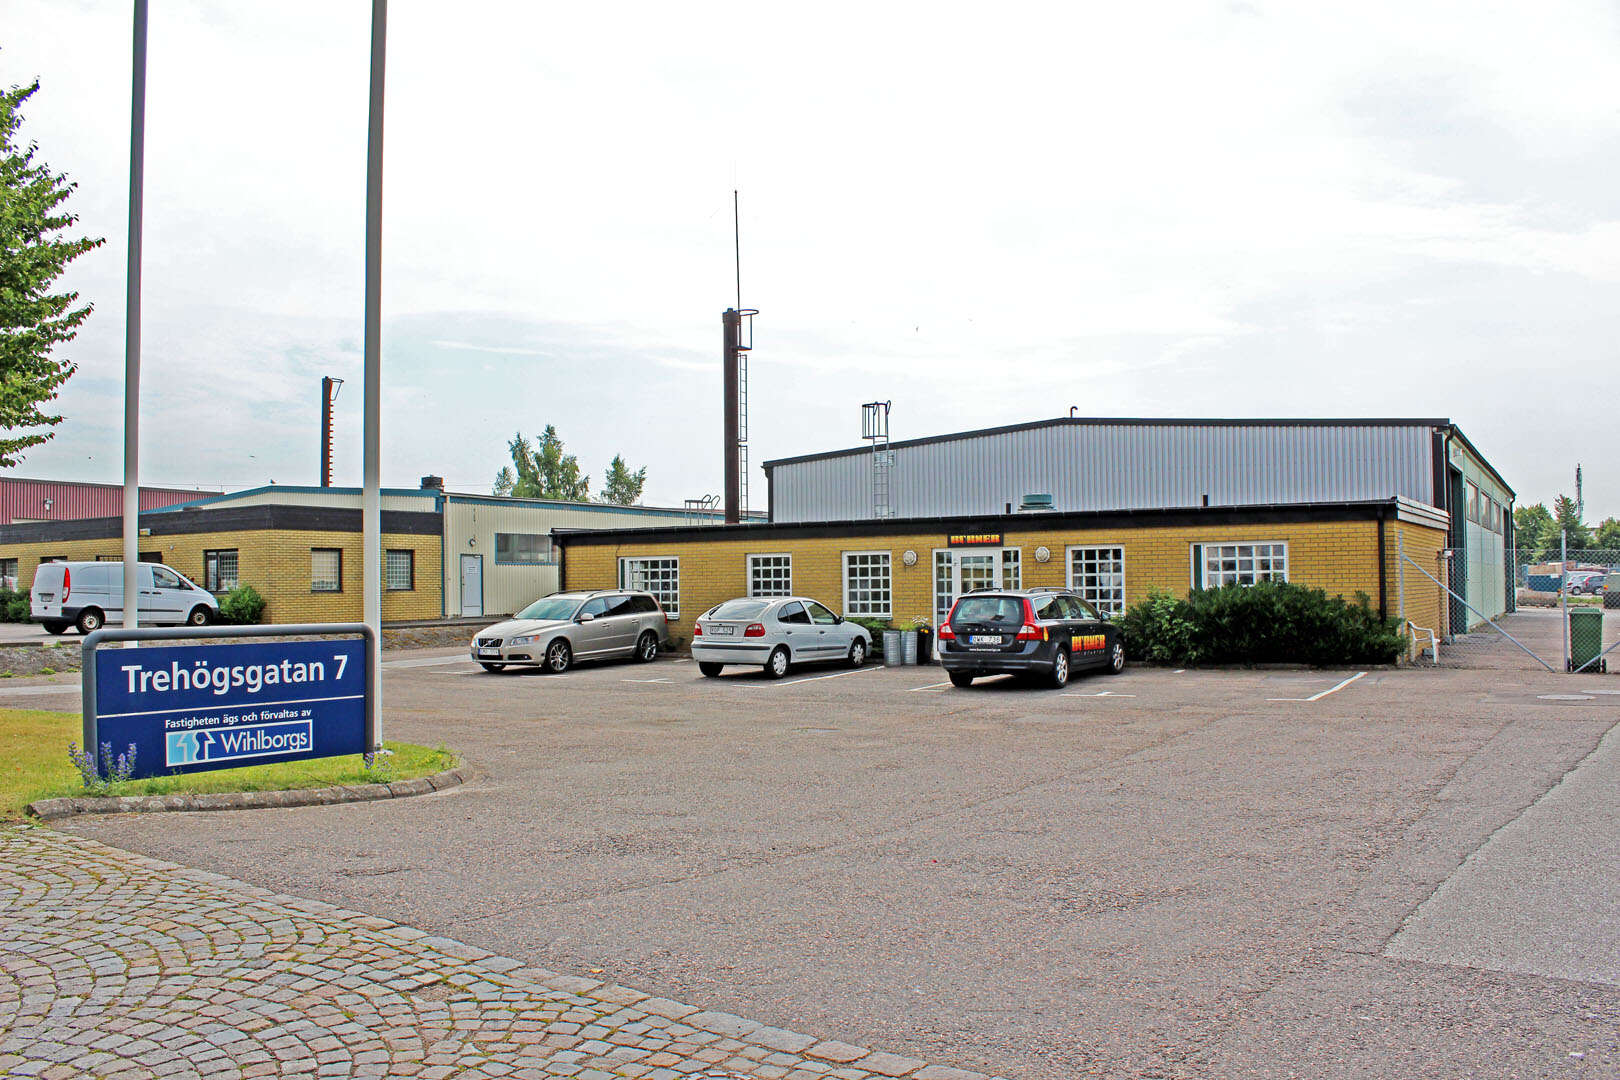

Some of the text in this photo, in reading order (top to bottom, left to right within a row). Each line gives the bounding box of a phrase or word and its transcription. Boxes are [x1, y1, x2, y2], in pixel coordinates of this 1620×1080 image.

[121, 655, 348, 695] Trehögsgatan 7
[165, 709, 312, 729] Fastigheten ägs och förvaltas av
[220, 729, 308, 752] Wihlborgs
